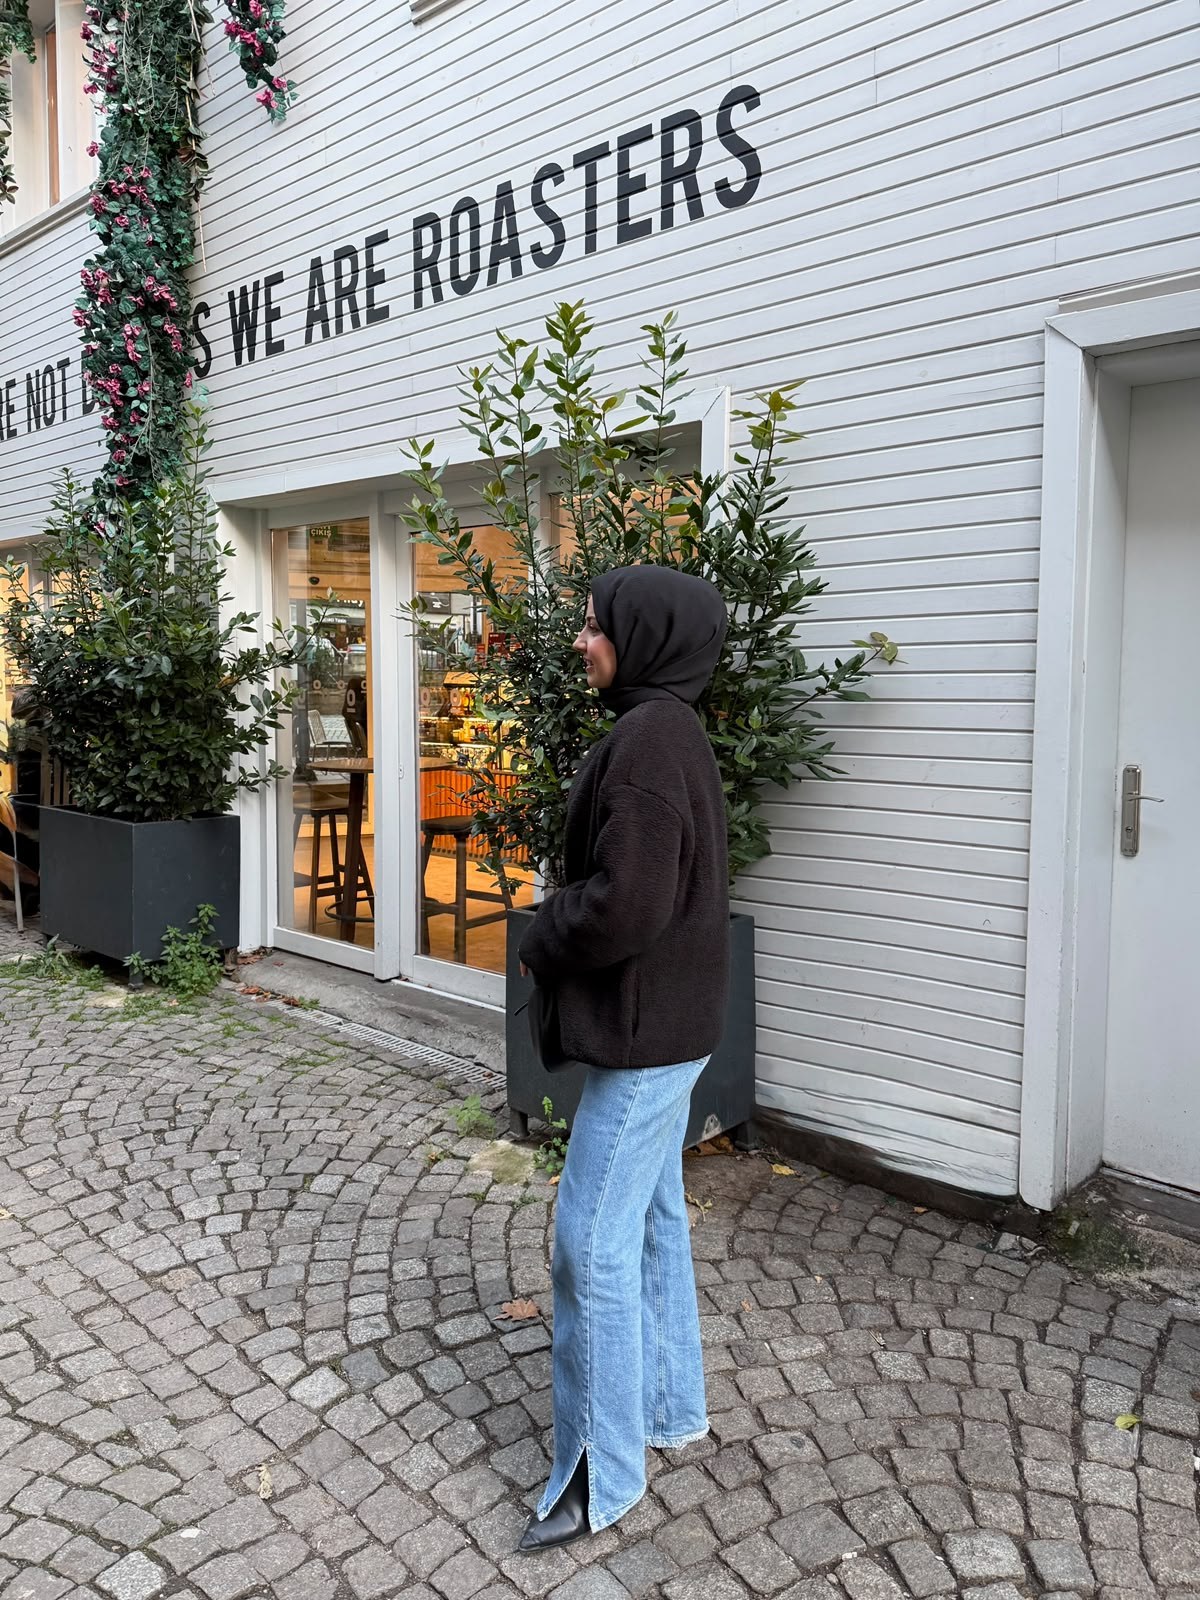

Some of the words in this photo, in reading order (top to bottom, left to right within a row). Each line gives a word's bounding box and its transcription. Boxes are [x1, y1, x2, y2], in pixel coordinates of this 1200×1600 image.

[0, 378, 18, 441] E
[26, 357, 70, 433] NOT
[227, 270, 285, 367] WE
[304, 228, 390, 345] ARE
[413, 84, 762, 310] ROASTERS
